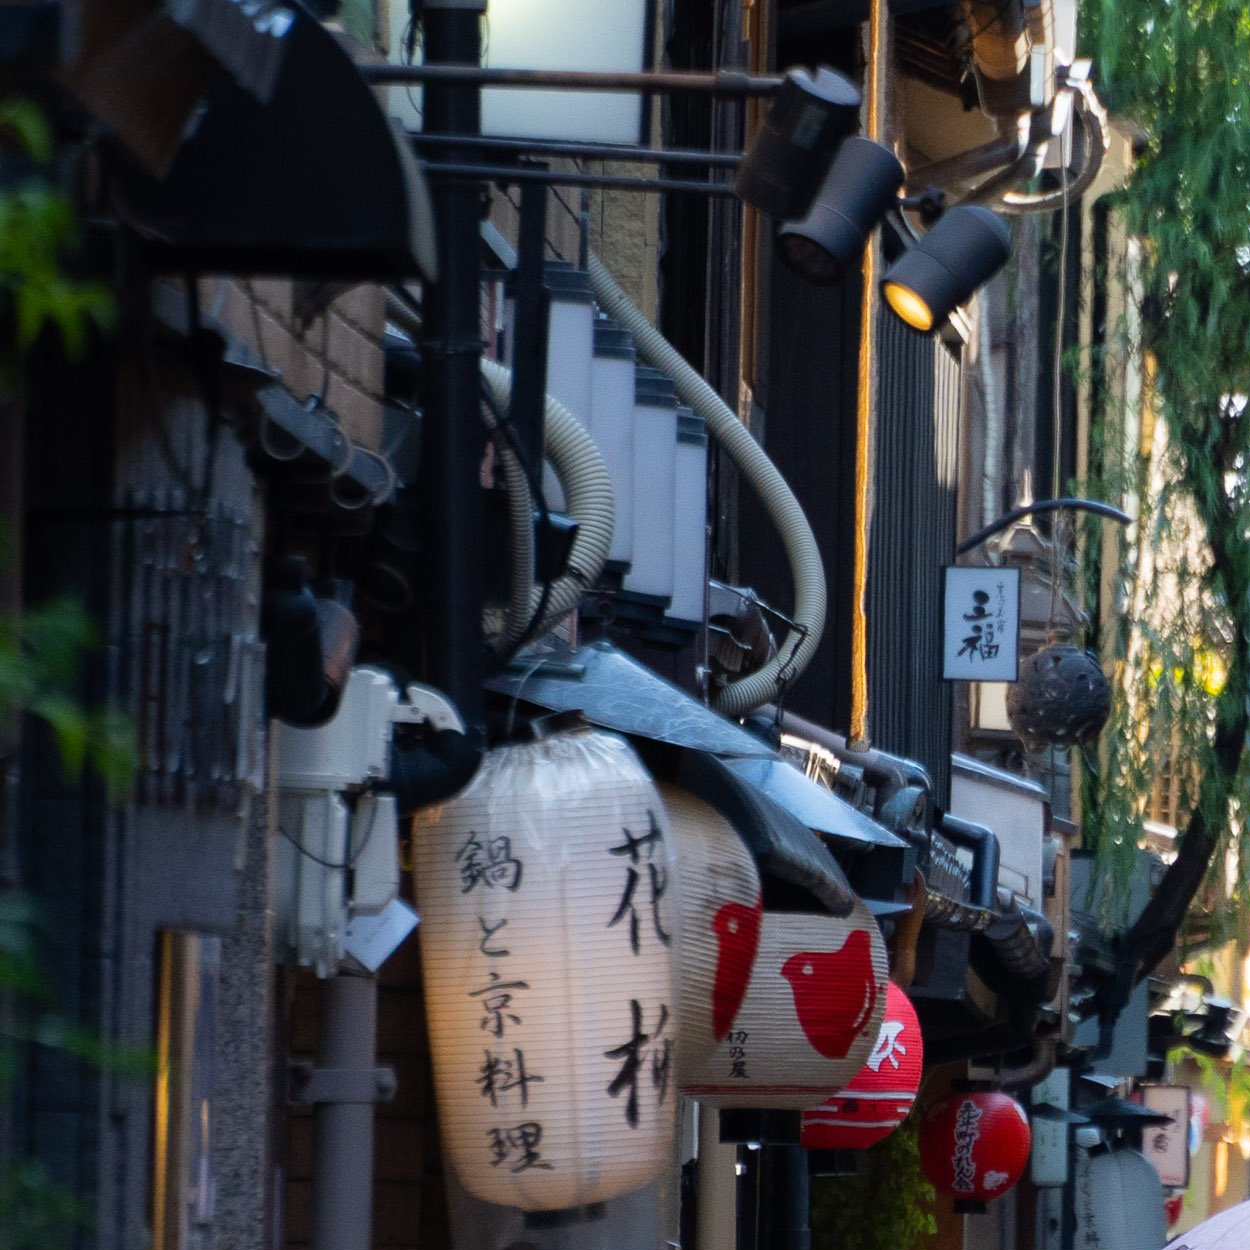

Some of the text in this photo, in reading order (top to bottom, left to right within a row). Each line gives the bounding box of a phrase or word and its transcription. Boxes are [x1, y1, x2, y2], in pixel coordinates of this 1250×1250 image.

[455, 831, 555, 1172] 鍋と京料理
